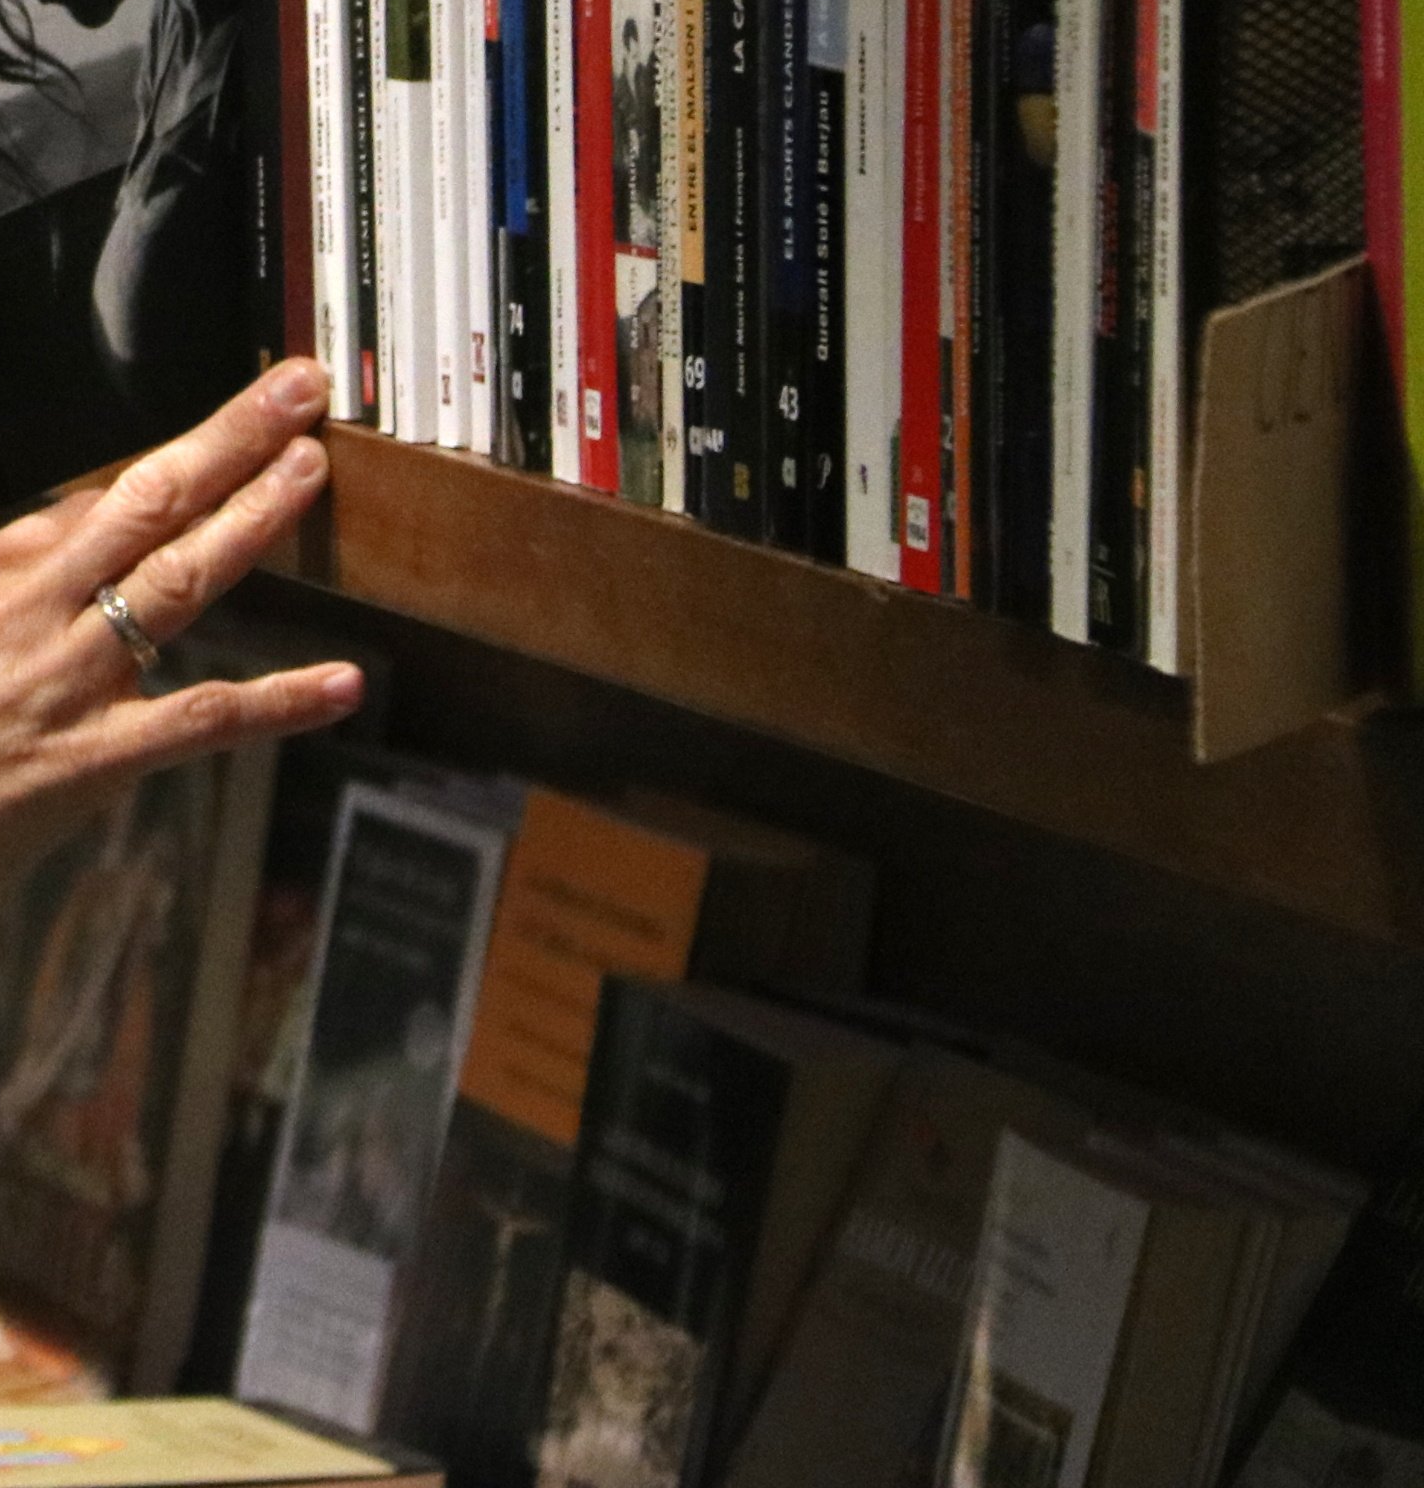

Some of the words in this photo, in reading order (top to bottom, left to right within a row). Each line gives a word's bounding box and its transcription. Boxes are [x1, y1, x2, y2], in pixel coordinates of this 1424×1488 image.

[354, 14, 366, 61] ELS
[731, 38, 746, 74] LA
[313, 66, 323, 99] era
[685, 24, 697, 120] MALSON
[313, 105, 326, 168] temps
[553, 106, 563, 135] LA
[687, 128, 698, 155] EL
[814, 90, 832, 175] Barjau
[782, 117, 796, 208] MORTS
[254, 154, 268, 230] Preston
[687, 162, 699, 232] ENTRE
[315, 200, 327, 254] Quan
[359, 202, 372, 285] JAUME
[782, 217, 796, 260] ELS
[815, 202, 831, 260] Solé
[256, 233, 269, 279] Paul
[507, 303, 525, 336] 74
[815, 268, 831, 362] Queralt
[684, 355, 706, 390] 69
[735, 351, 747, 397] Joan
[777, 384, 800, 422] 43
